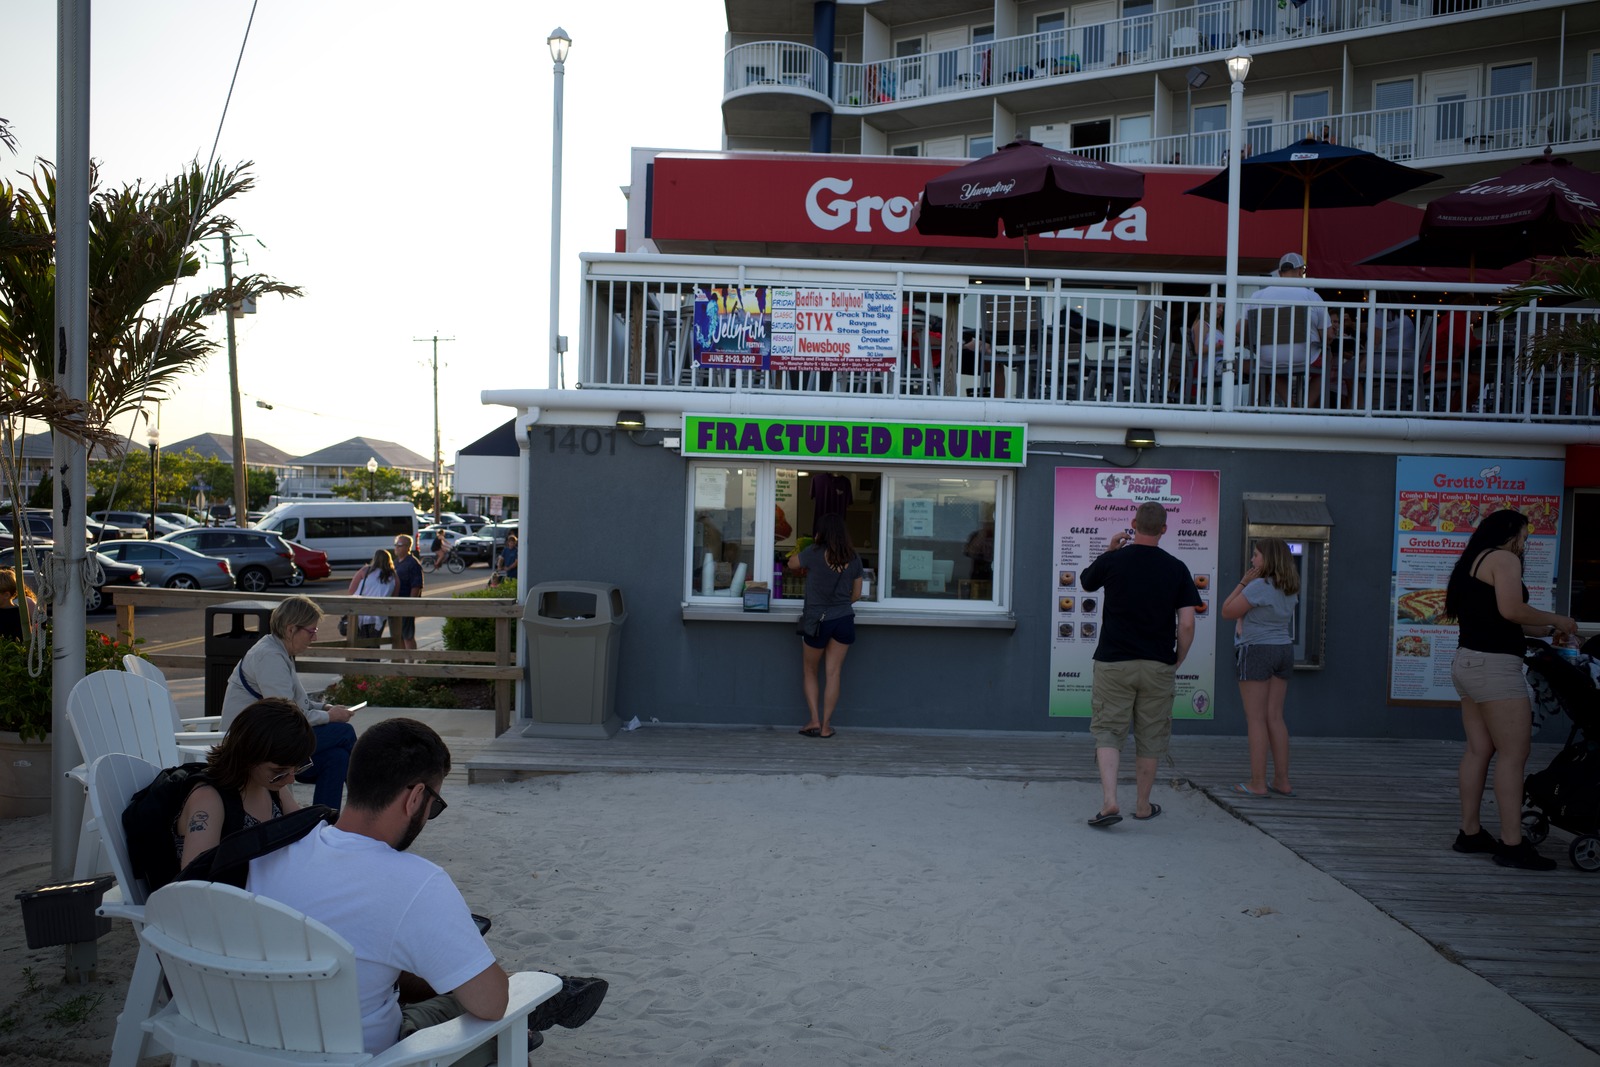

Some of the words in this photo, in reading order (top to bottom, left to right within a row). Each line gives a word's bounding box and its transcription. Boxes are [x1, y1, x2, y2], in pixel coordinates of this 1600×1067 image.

[960, 178, 1016, 200] Yuengling
[805, 177, 927, 232] Gro
[1500, 210, 1532, 220] BREWERY
[832, 292, 864, 311] Ballyhoo!
[864, 291, 874, 302] King
[796, 312, 833, 331] STYX
[712, 311, 766, 350] Jellyfish
[772, 346, 794, 354] SUNDAY
[798, 338, 850, 357] Newsboys
[725, 355, 741, 363] 21-23,
[544, 428, 617, 456] 1401
[697, 422, 892, 455] FRACTURED
[902, 428, 1012, 459] PRUNE
[1122, 475, 1168, 485] FRACTURED
[1434, 474, 1484, 488] Grotto
[1486, 475, 1526, 490] Pizza
[1128, 485, 1161, 494] PRUNE
[1462, 500, 1471, 512] 2
[1409, 538, 1440, 547] Grotto
[1441, 538, 1466, 548] Pizza
